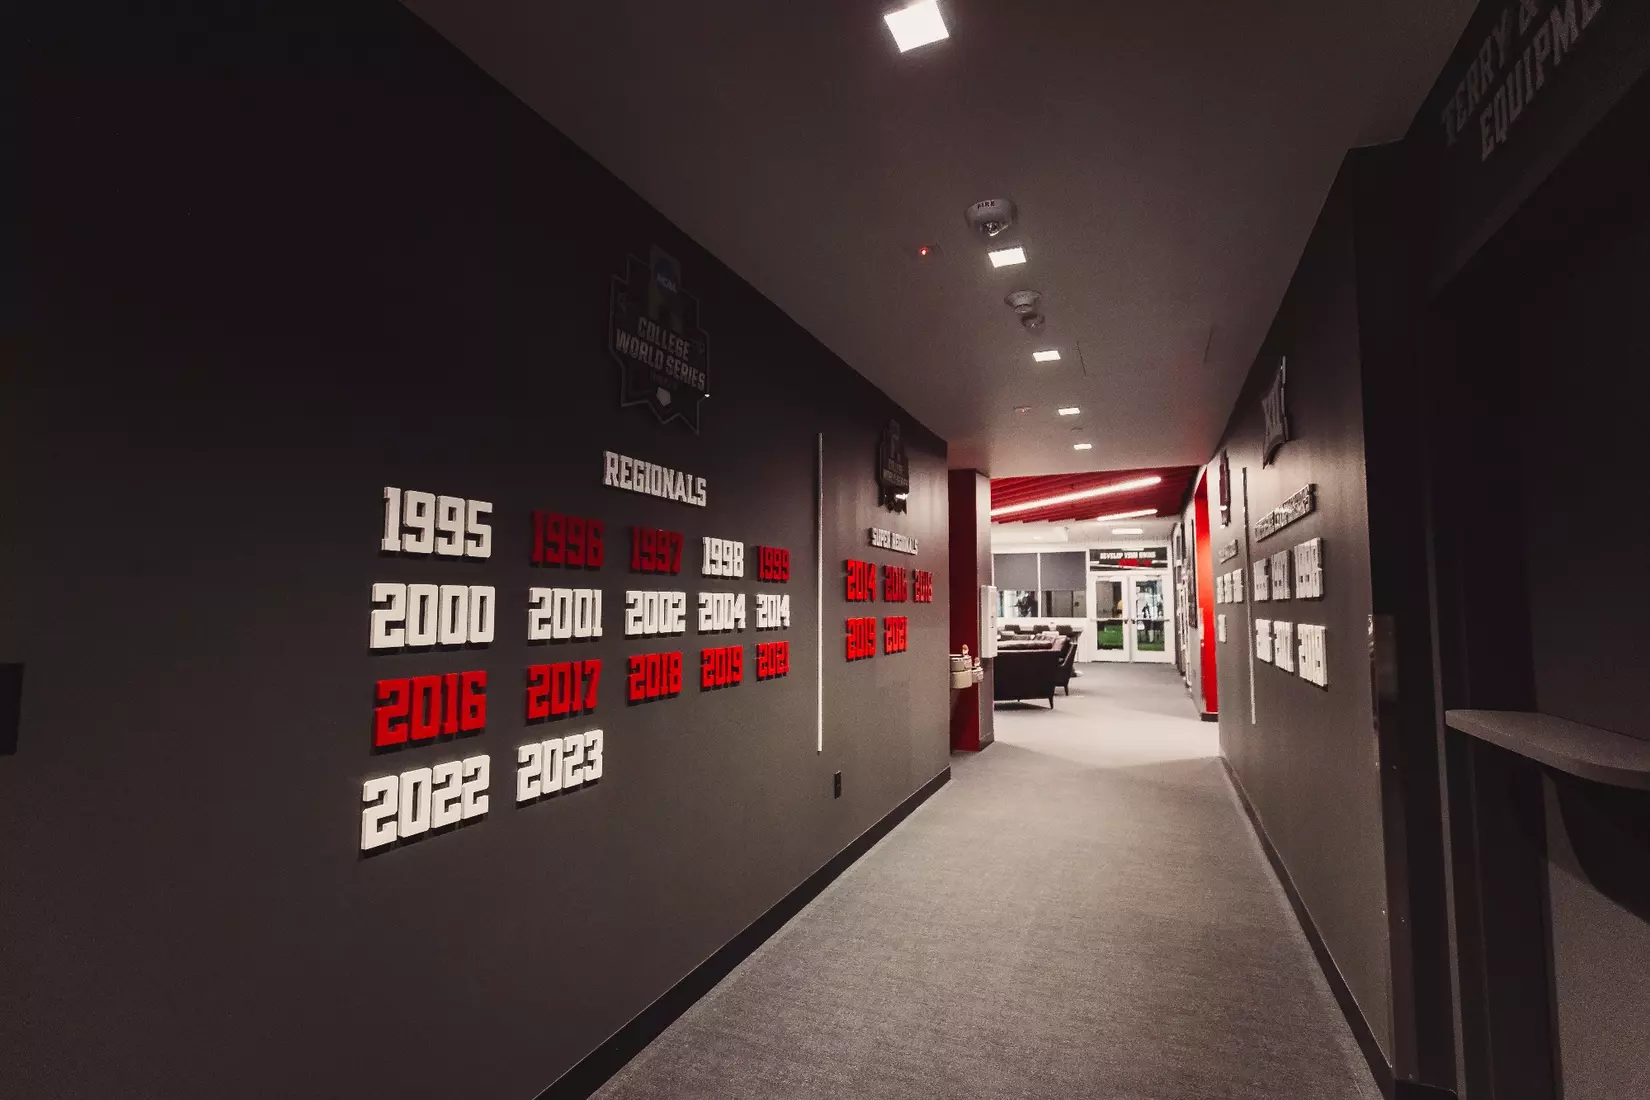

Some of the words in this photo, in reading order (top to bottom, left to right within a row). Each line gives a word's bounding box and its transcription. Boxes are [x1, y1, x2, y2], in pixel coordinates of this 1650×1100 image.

[1441, 5, 1512, 148] TERRY
[977, 200, 996, 210] FIRE
[615, 328, 665, 371] WORLD
[665, 356, 706, 391] SERIES
[637, 316, 691, 360] COLLEGE
[603, 450, 707, 507] REGIONALS
[381, 486, 493, 559] 1995
[531, 509, 605, 569] 1996
[631, 525, 684, 574] 1997
[702, 536, 745, 578] 1998
[757, 545, 790, 581] 1999
[846, 558, 877, 602] 2014
[369, 582, 496, 649] 2000
[528, 587, 603, 641] 2001
[625, 590, 687, 636] 2002
[698, 592, 746, 632] 2004
[756, 594, 791, 629] 2014
[845, 617, 877, 661] 2019
[884, 616, 909, 654] 2021
[374, 670, 488, 747] 2016
[526, 659, 603, 720] 2017
[627, 651, 684, 701] 2018
[701, 645, 744, 688] 2019
[757, 641, 790, 679] 2021
[361, 754, 491, 851] 2022
[516, 729, 604, 803] 2023
